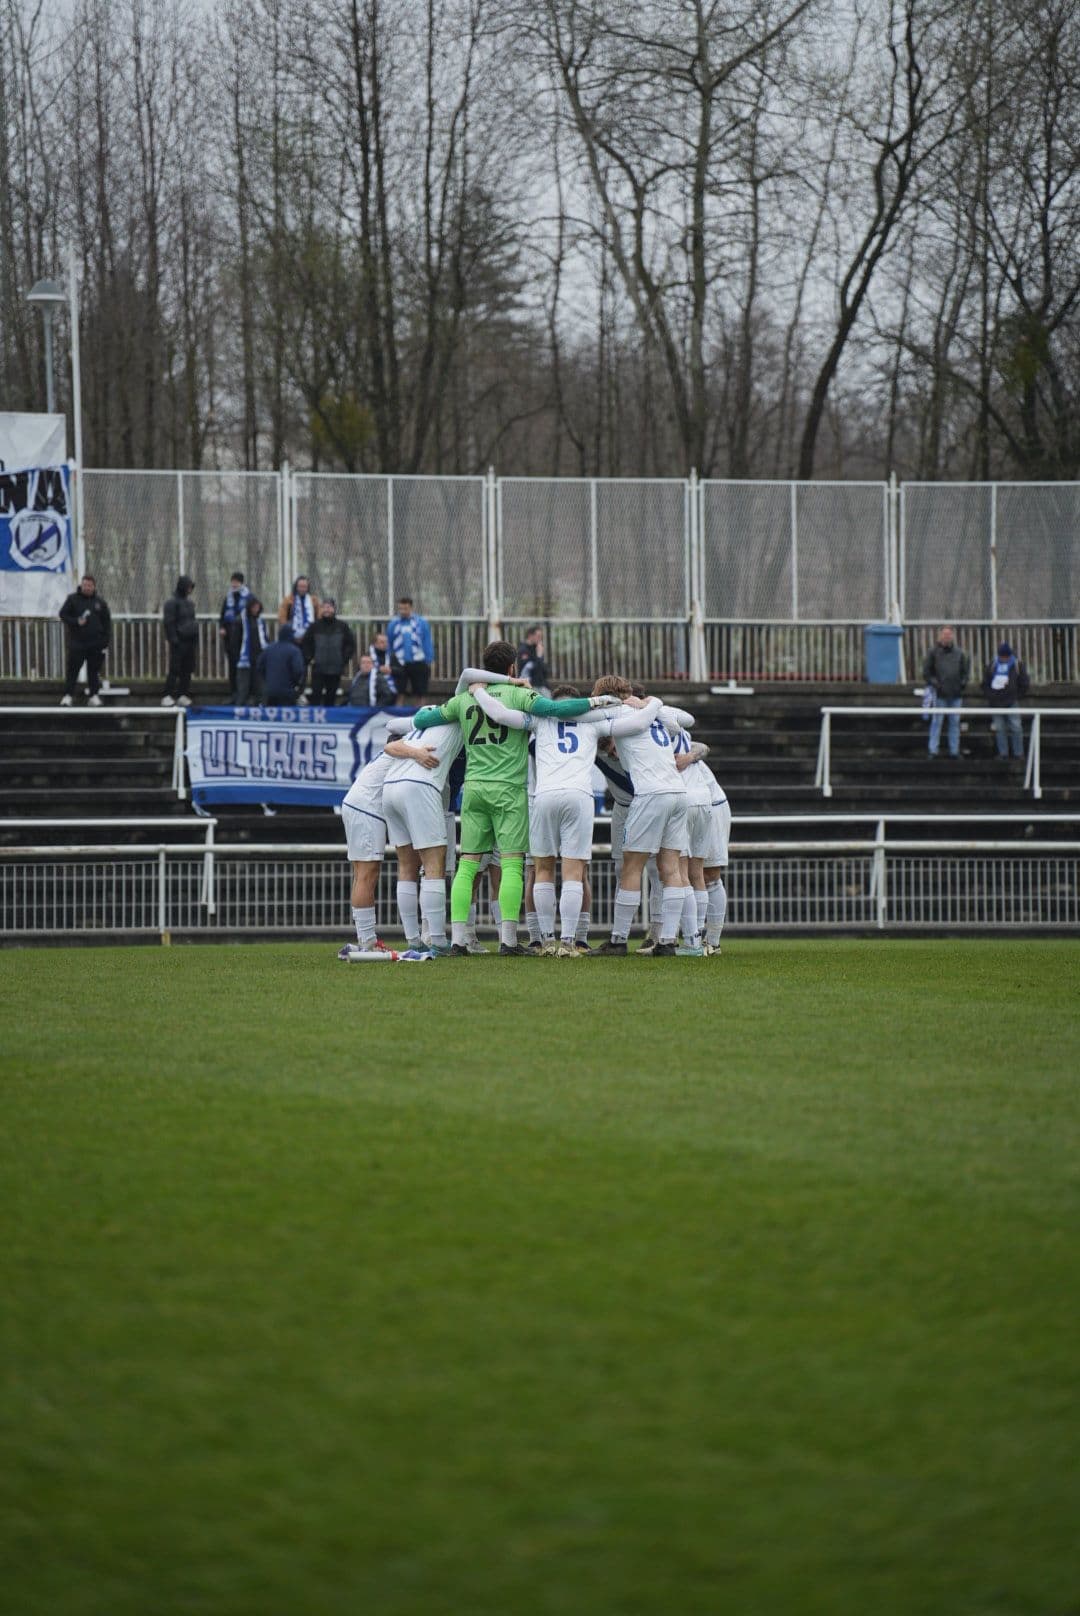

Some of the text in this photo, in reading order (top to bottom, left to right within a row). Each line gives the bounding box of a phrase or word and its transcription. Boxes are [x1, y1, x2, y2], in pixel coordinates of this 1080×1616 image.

[466, 704, 508, 745] 29
[557, 720, 578, 753] 5
[201, 730, 338, 781] ULTRAS
